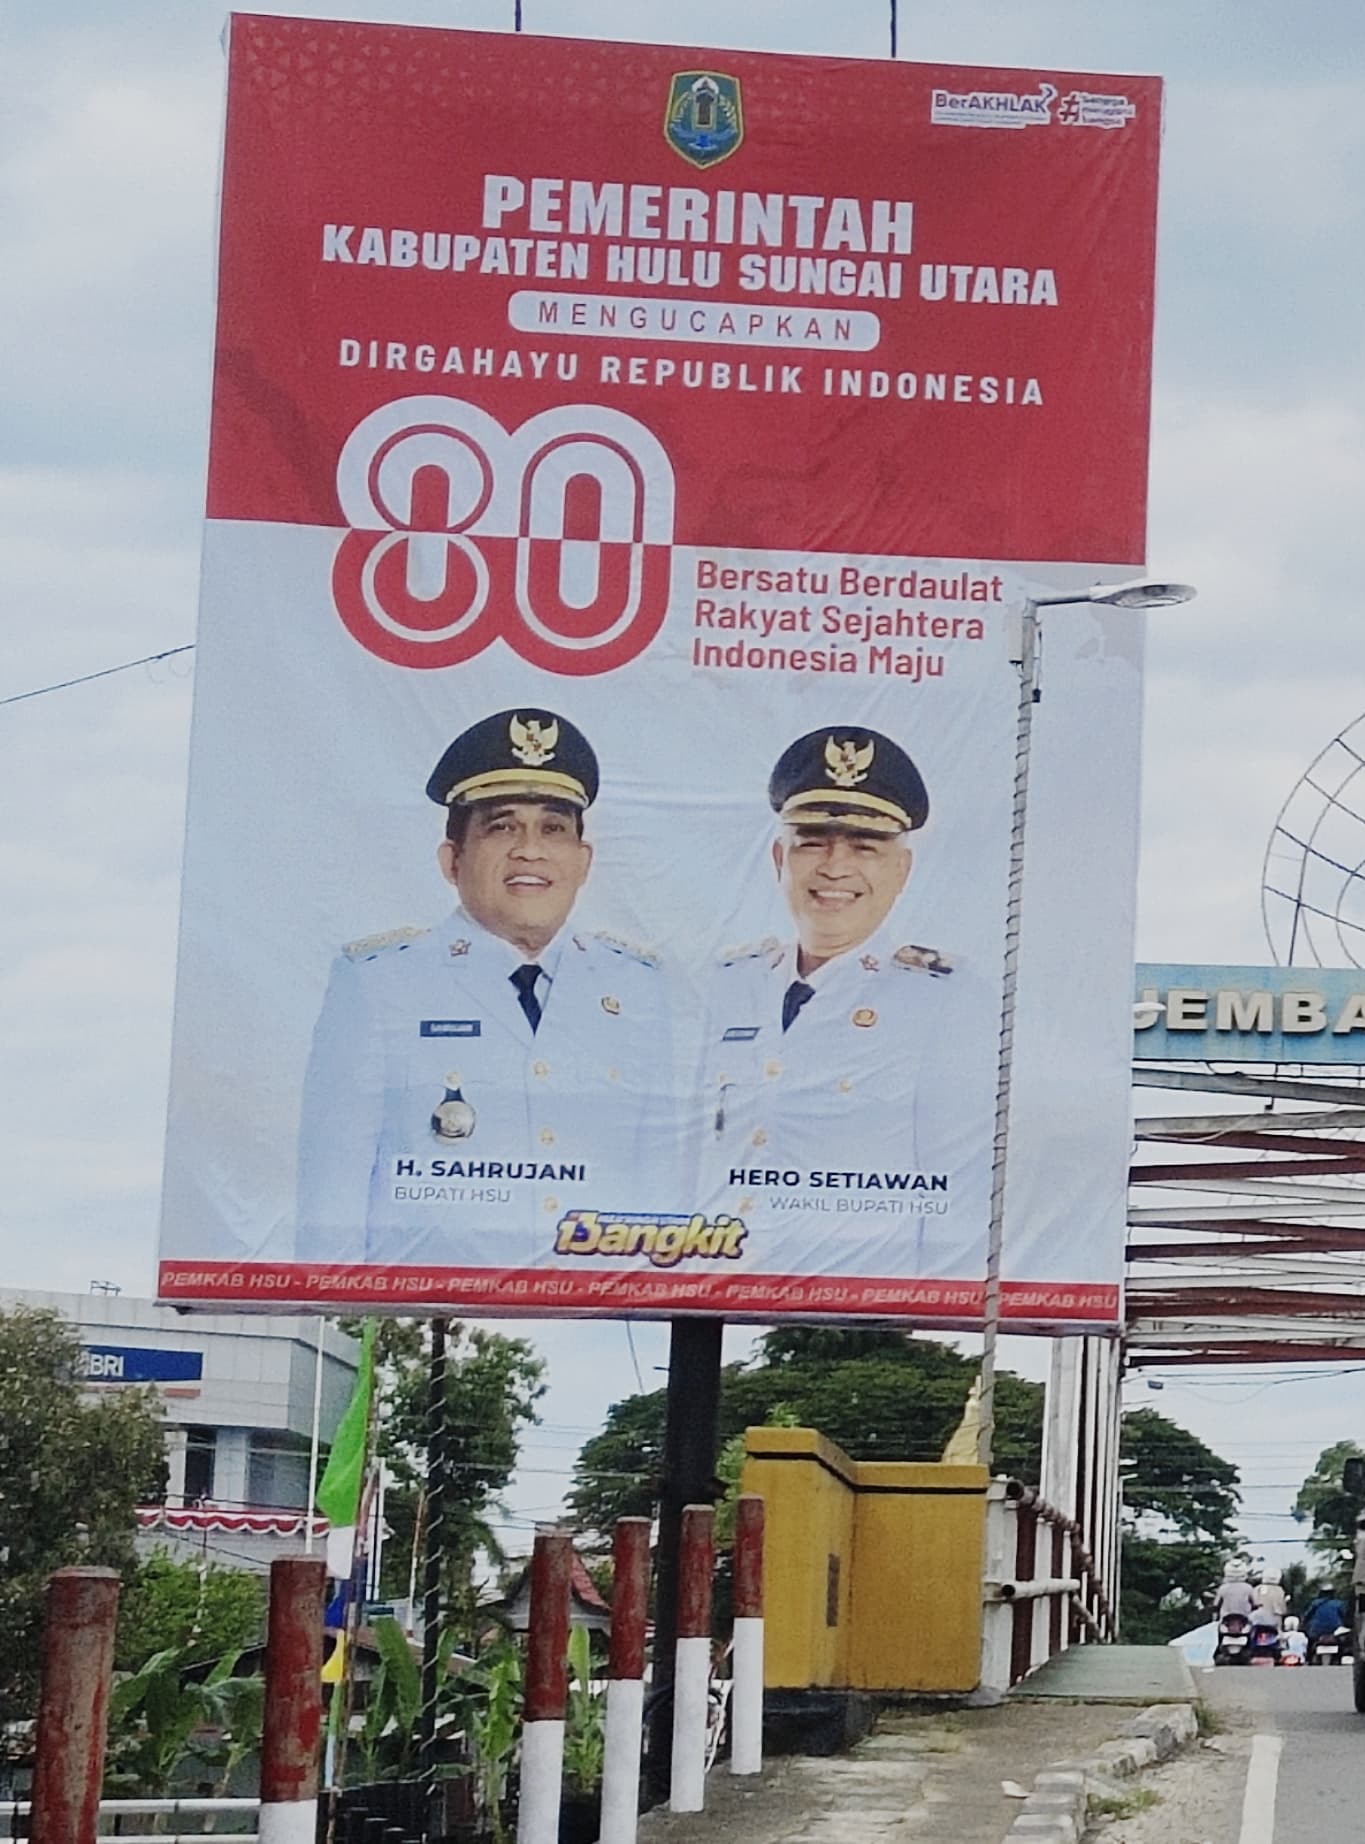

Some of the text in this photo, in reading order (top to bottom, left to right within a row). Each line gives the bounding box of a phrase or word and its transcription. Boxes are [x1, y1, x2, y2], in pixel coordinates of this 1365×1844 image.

[935, 92, 1046, 113] BerAKHLAK
[482, 174, 913, 255] PEMERINTAH
[322, 224, 1058, 306] KABUPATEN HULU SUNGAI UTARA
[538, 301, 851, 341] MENGUCAPKAN
[339, 338, 1044, 406] DIRGAHAYU REPUBLIK INDONESIA
[331, 394, 676, 676] 80
[697, 560, 1004, 602] Bersatu Berdaulat
[695, 599, 984, 642] Rakyat Sejahtera
[693, 637, 945, 683] Indonesia Maju
[396, 1159, 586, 1182] H. SAHRUJANI
[729, 1168, 948, 1191] HERO SETIAWAN
[395, 1186, 511, 1203] BUPATI HSU
[770, 1195, 948, 1215] WAKIL BUPATI HSU
[161, 1271, 244, 1288] PEMKAB
[250, 1275, 290, 1289] HSU
[306, 1275, 387, 1291] PEMKAB
[393, 1278, 433, 1292] HSU
[447, 1278, 527, 1295] PEMKAB
[533, 1282, 574, 1296] HSU
[589, 1282, 667, 1298] PEMKAB
[671, 1284, 711, 1299] HSU
[726, 1285, 804, 1301] PEMKAB
[809, 1288, 847, 1302] HSU
[863, 1288, 939, 1304] PEMKAB
[944, 1291, 982, 1305] HSU
[1000, 1292, 1074, 1308] PEMKAB
[1080, 1295, 1117, 1309] HSU
[90, 1354, 124, 1376] BRI
